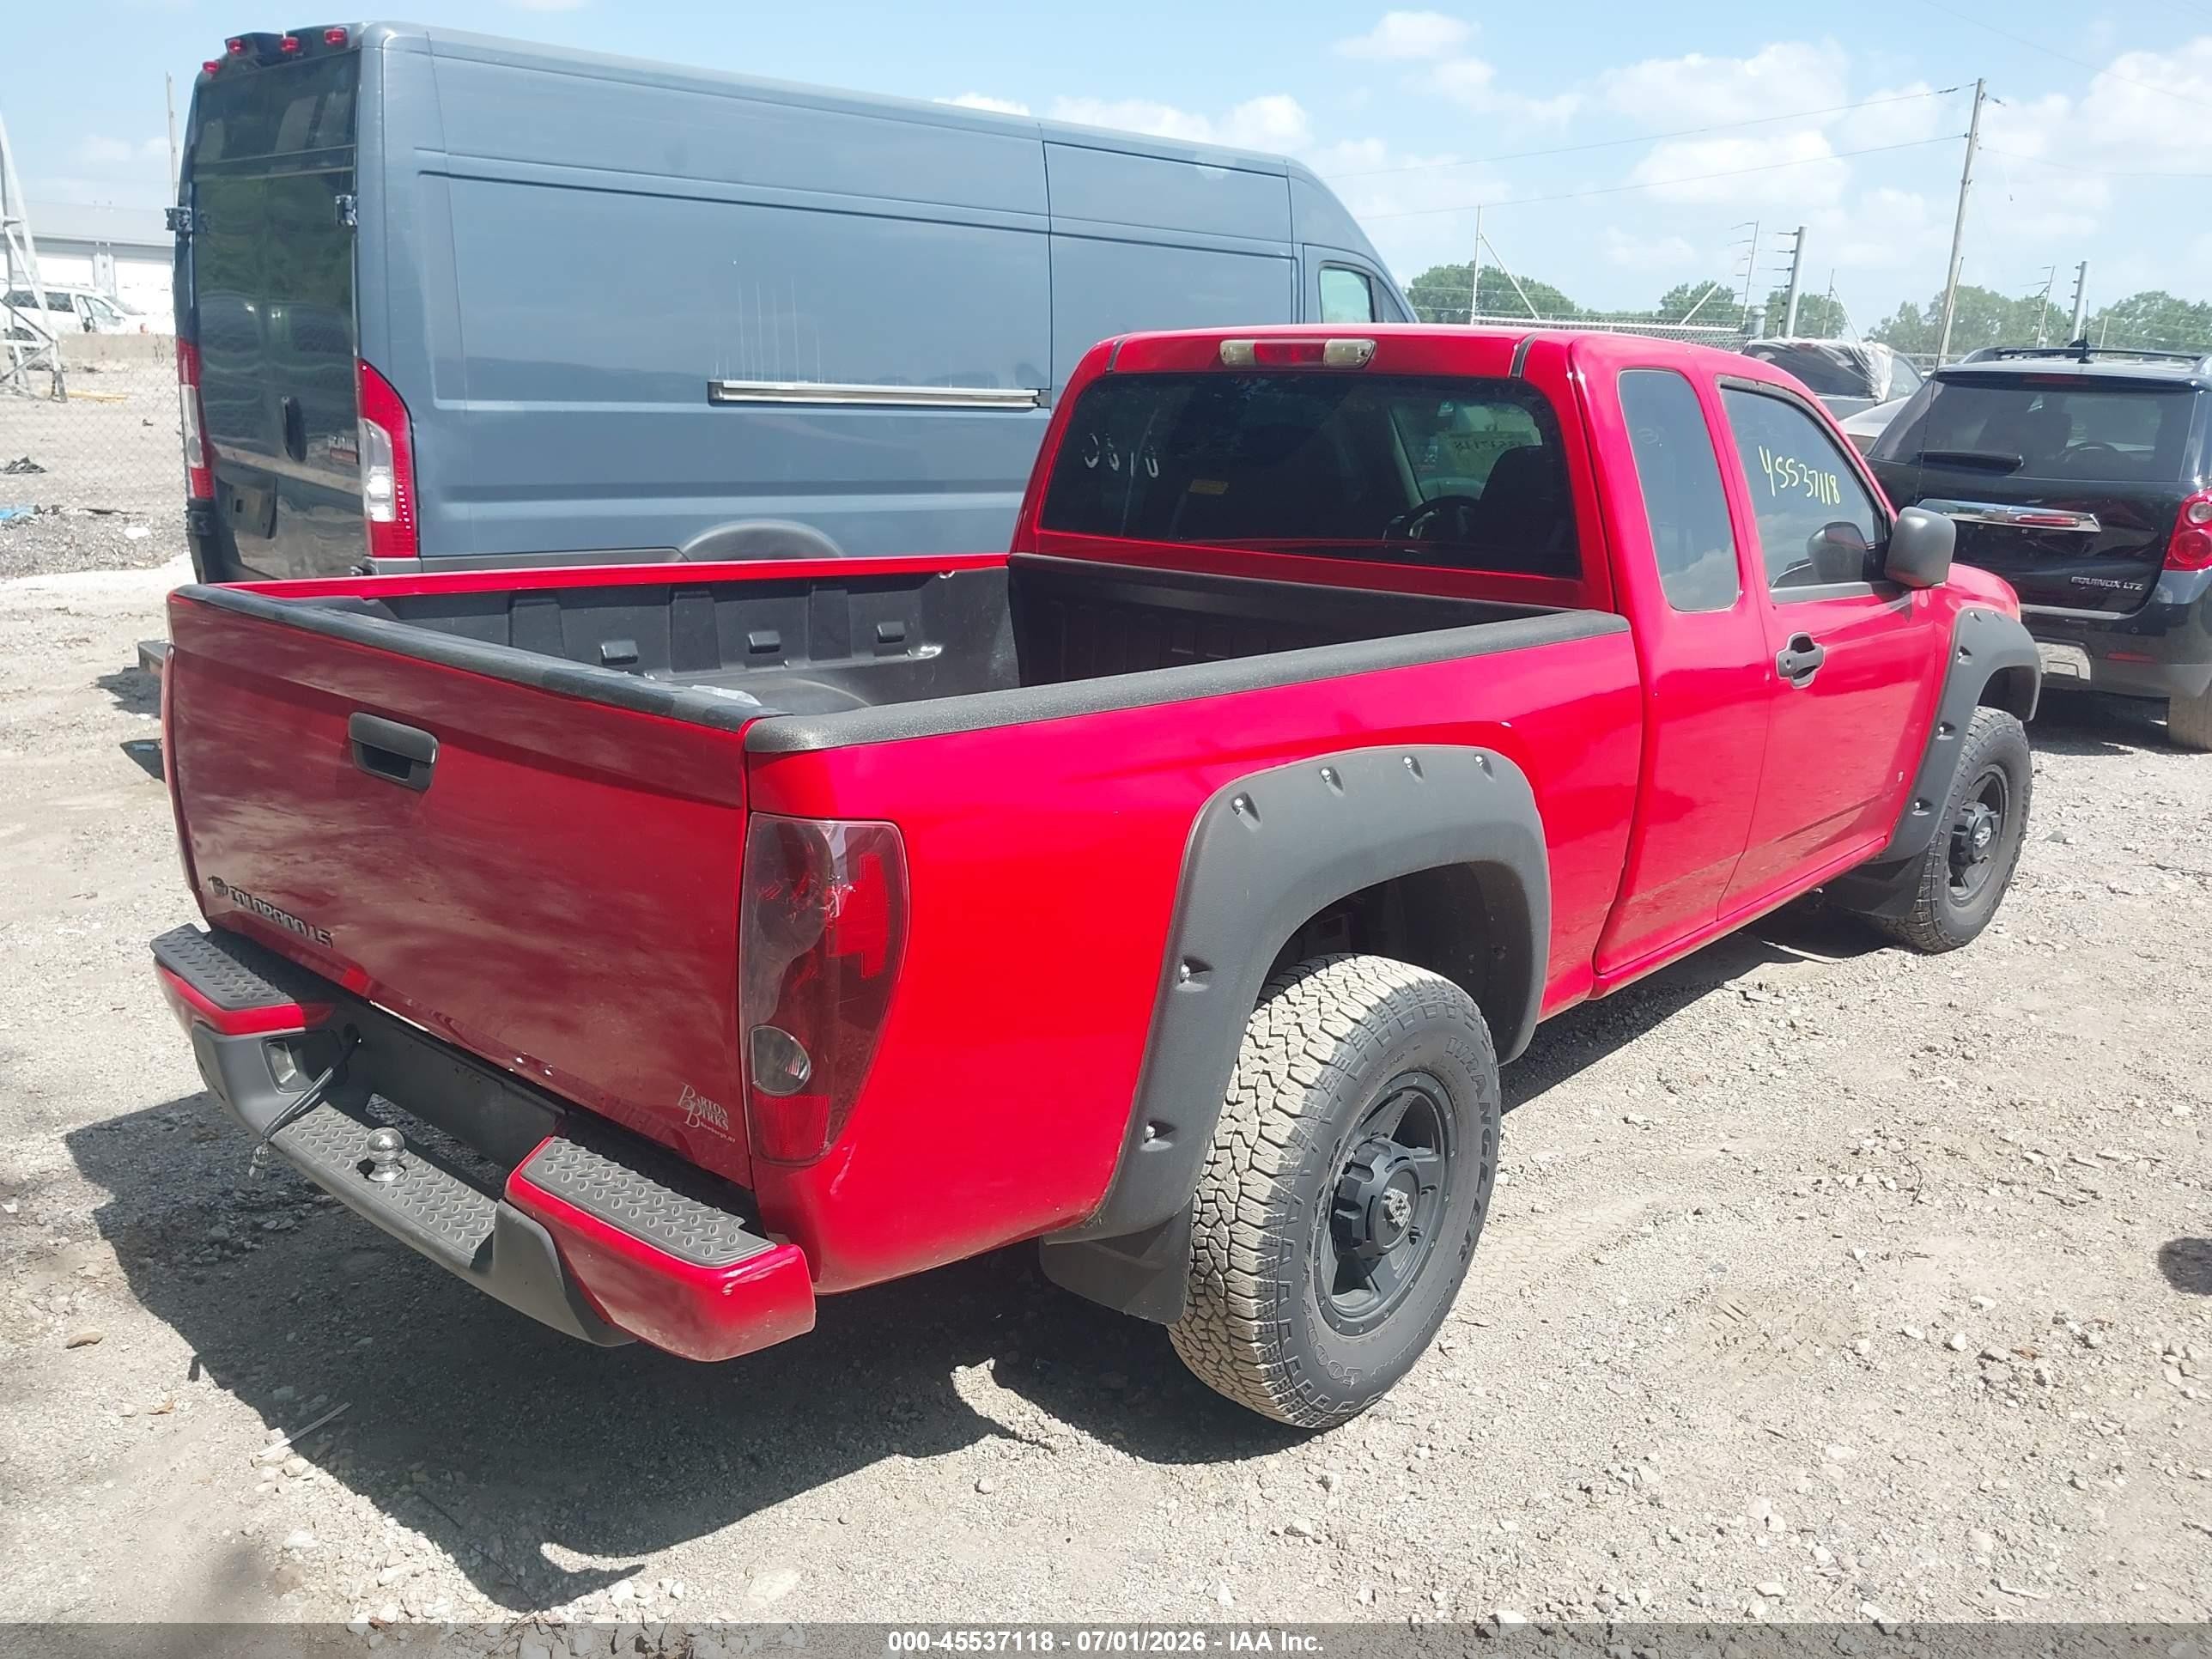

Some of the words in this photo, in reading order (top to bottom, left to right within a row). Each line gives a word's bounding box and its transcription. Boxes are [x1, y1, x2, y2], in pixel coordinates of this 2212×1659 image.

[1759, 445, 1841, 506] 45537118
[2070, 576, 2121, 588] EQUINOX
[2123, 581, 2144, 591] LTZ
